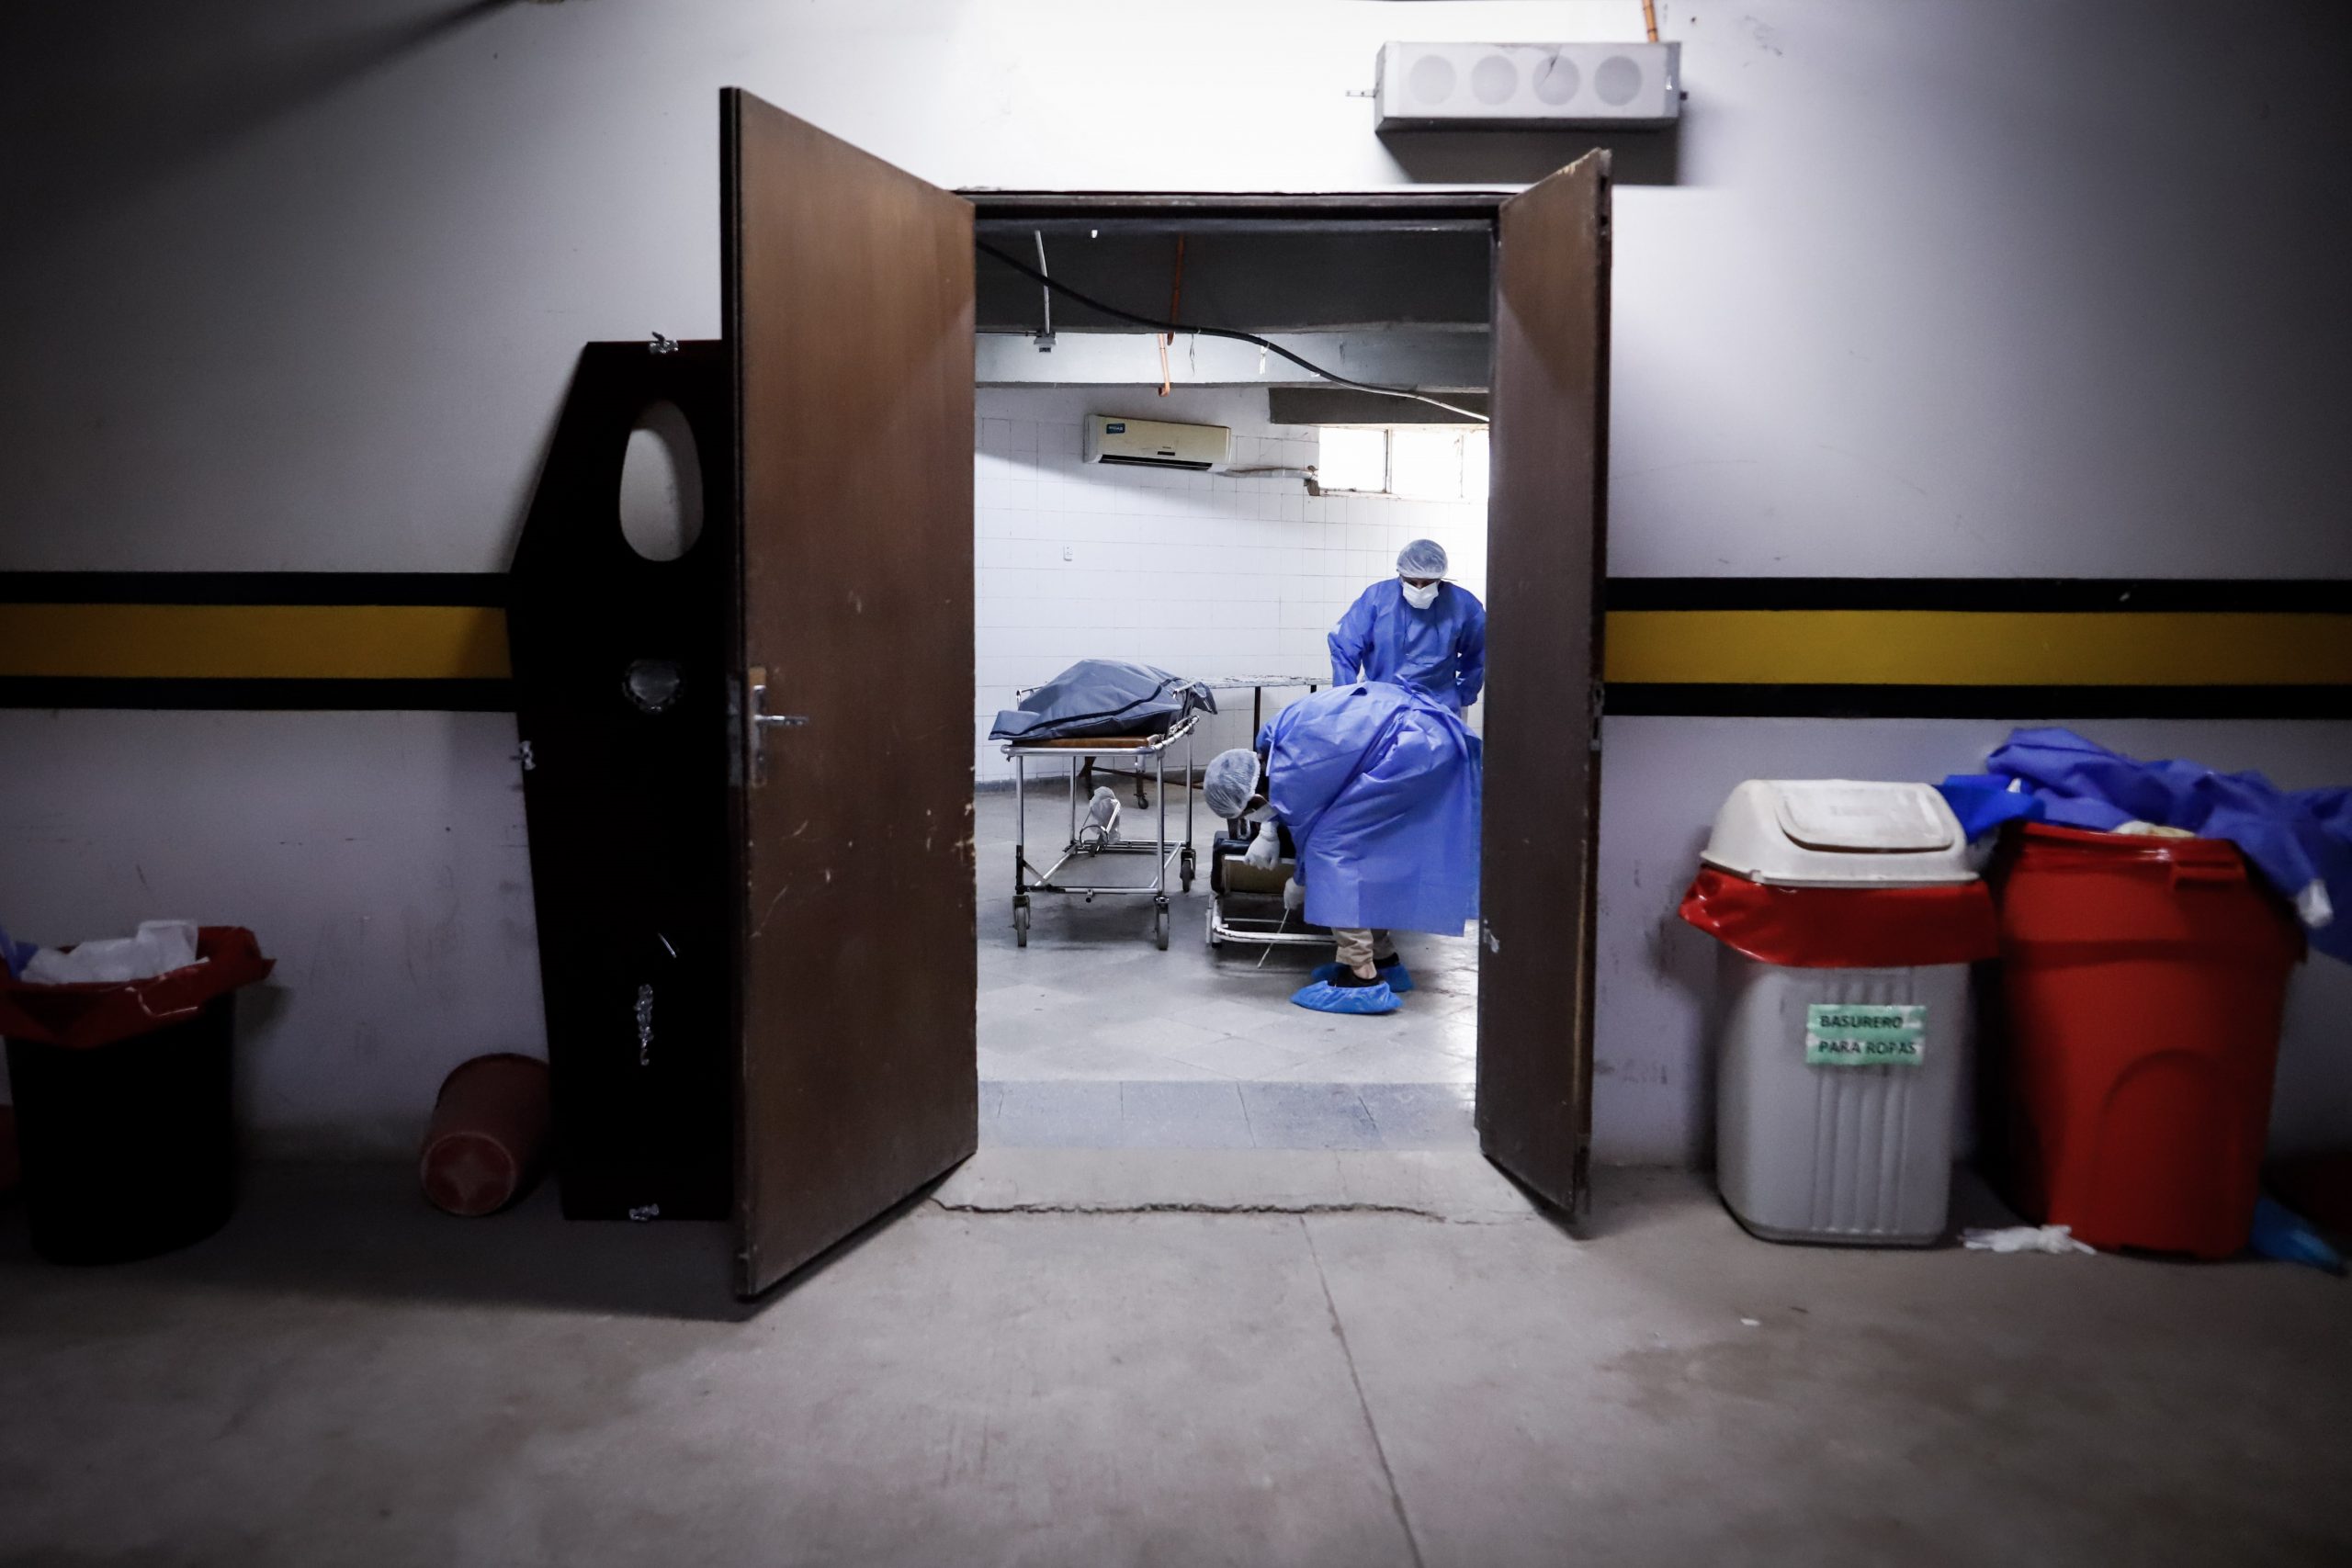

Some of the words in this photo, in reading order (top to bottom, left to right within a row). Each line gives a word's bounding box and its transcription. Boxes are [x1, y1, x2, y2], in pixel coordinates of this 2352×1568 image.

[1821, 1015, 1904, 1029] BASURERO
[1818, 1041, 1860, 1054] PARA
[1866, 1042, 1917, 1055] ROPAS
